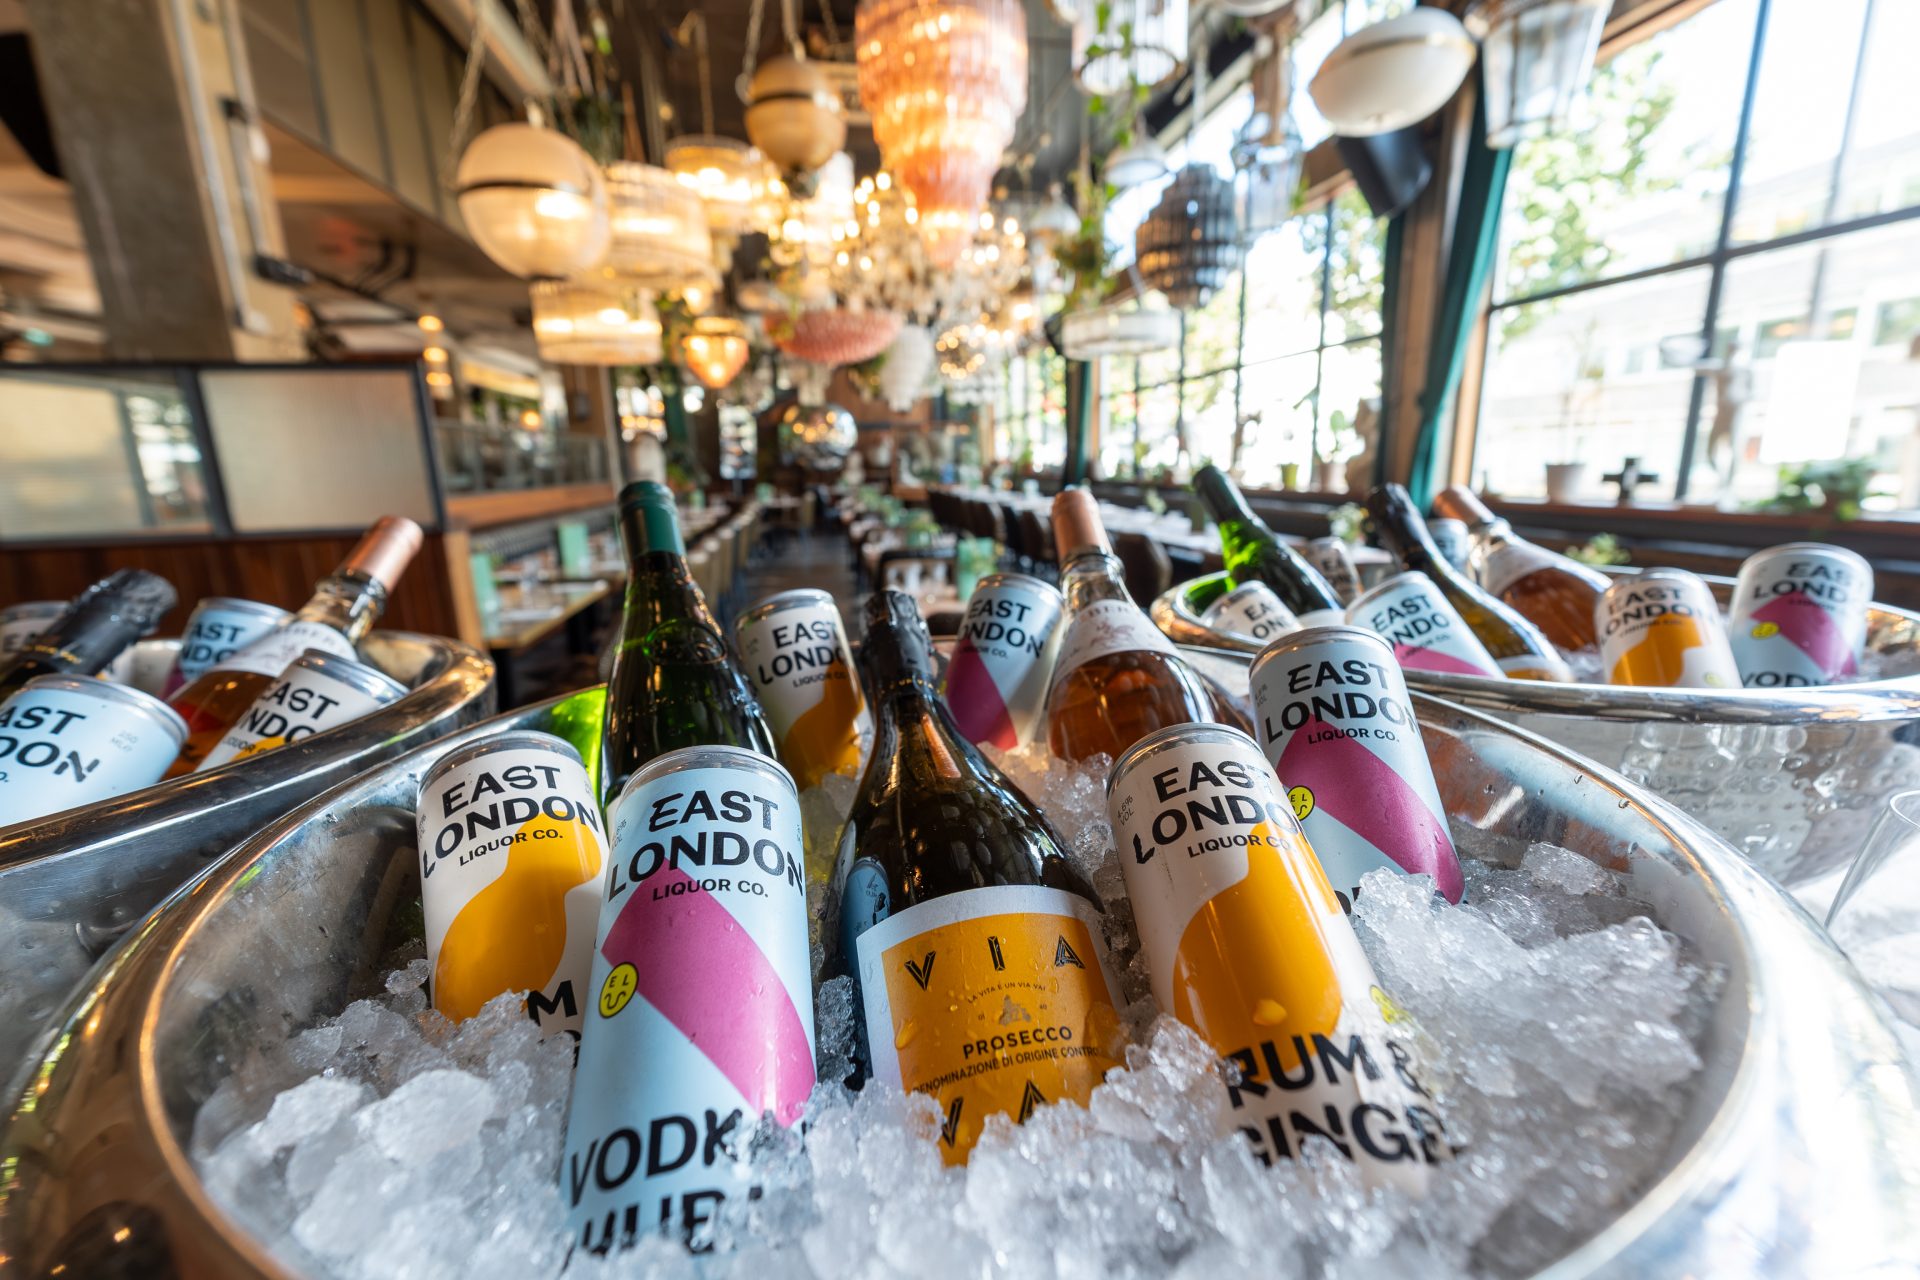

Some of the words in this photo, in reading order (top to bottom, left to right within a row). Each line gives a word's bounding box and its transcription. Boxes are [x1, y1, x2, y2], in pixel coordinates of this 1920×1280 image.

[969, 598, 1031, 622] EAST
[1753, 581, 1846, 603] LOND
[1372, 594, 1432, 632] EAST
[963, 621, 1043, 659] ONDON
[758, 646, 843, 685] LONDO
[1287, 660, 1389, 694] EAST
[1739, 671, 1832, 688] VOD
[0, 706, 87, 735] AST
[1308, 728, 1369, 745] LIQUOR
[1374, 729, 1400, 743] CO.
[442, 765, 561, 819] EAST
[1153, 761, 1271, 804] EAST
[649, 790, 779, 833] EAST
[423, 795, 599, 878] LONDON
[459, 832, 528, 867] LIQUOR
[532, 828, 563, 841] CO.
[1187, 834, 1263, 859] LIQUOR
[608, 831, 804, 902] LONDON
[652, 878, 730, 901] LIQUOR
[738, 880, 769, 898] CO.
[968, 993, 978, 1004] LA
[979, 986, 996, 997] VITA
[1033, 983, 1046, 992] VAI
[963, 1025, 1073, 1060] PROSECCO
[913, 1057, 1000, 1094] DENOMINAZIONE
[1002, 1053, 1014, 1067] DI
[1017, 1047, 1058, 1065] ORIGINE
[1225, 1033, 1383, 1109] RUM
[570, 1108, 743, 1209] VODK
